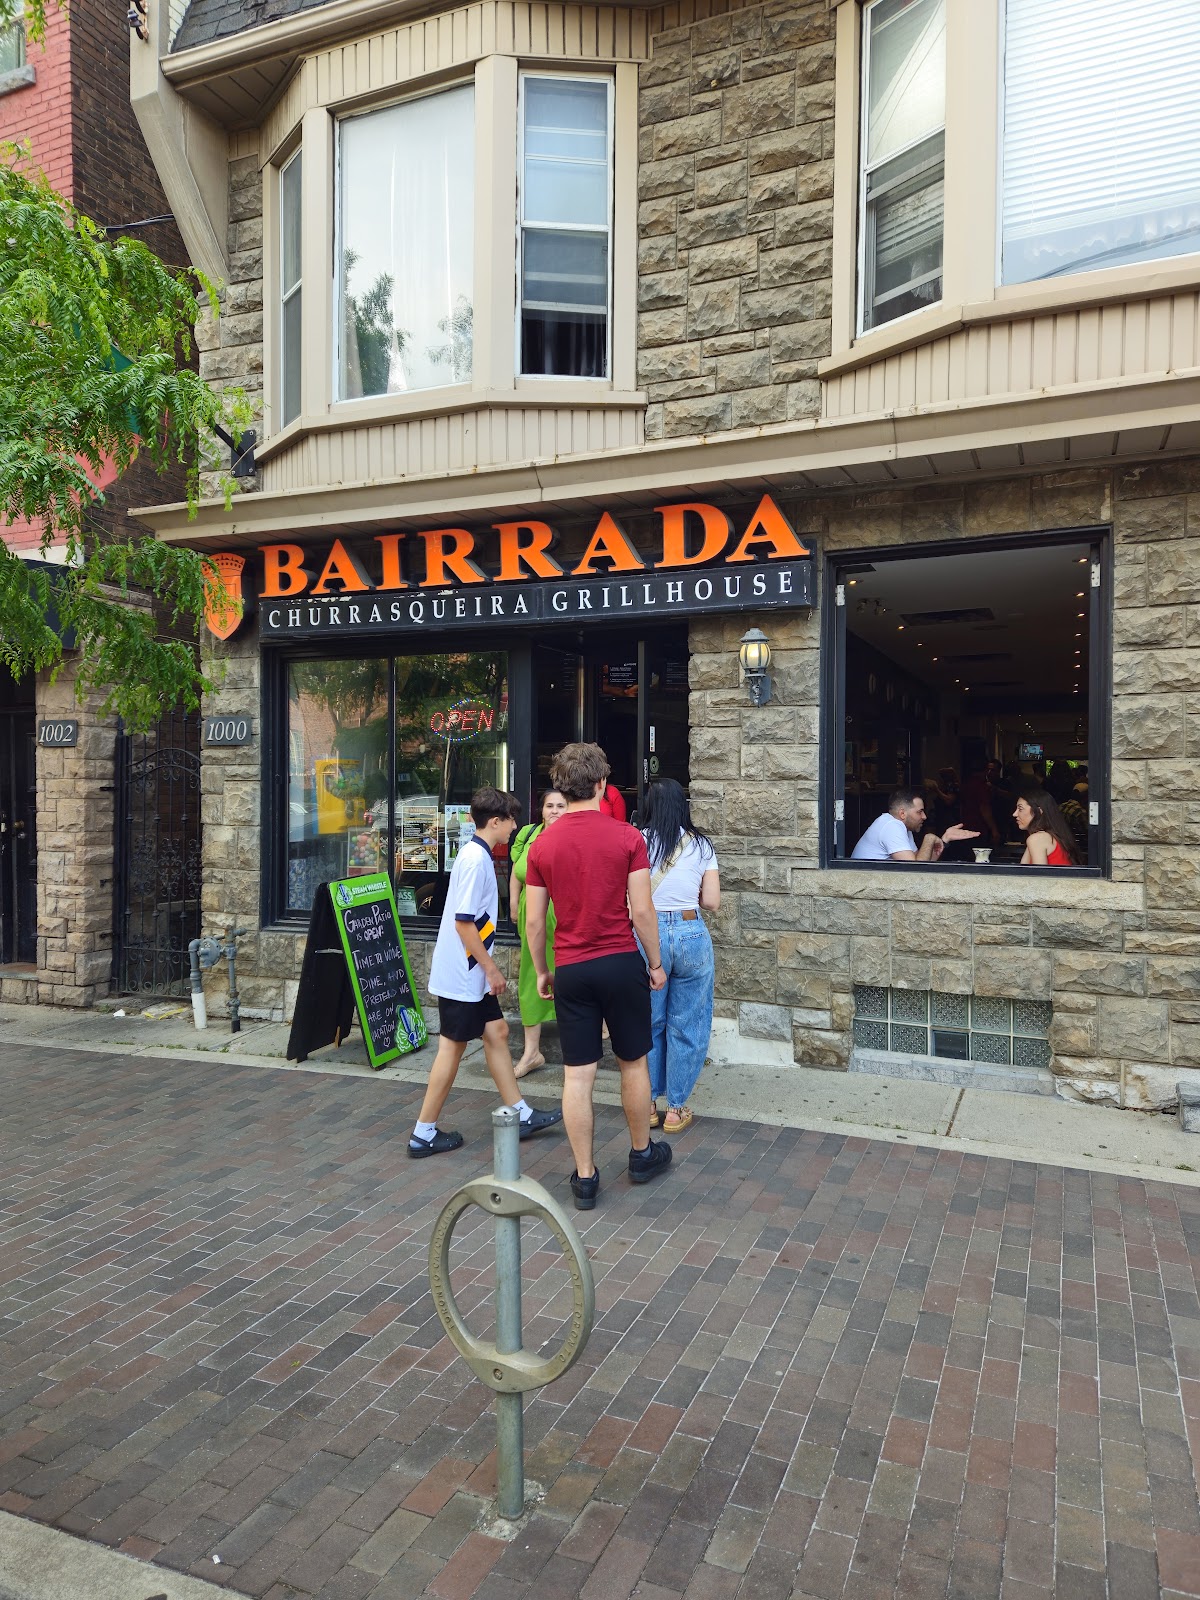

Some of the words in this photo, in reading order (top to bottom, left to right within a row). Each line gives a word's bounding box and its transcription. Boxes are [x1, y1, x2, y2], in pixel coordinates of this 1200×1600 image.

[258, 493, 810, 598] BAIRRADA
[268, 592, 530, 629] CHURRASQUEIRA
[551, 570, 795, 613] GRILLHOUSE
[206, 720, 248, 741] 1000
[430, 709, 495, 732] OPEN
[39, 724, 73, 743] 1002
[351, 885, 367, 895] STEAM
[397, 891, 413, 900] ASS
[344, 909, 374, 933] GARDEN
[352, 949, 375, 971] TIME
[399, 982, 410, 995] WE
[367, 1010, 382, 1024] ARE
[385, 1003, 394, 1017] ON
[556, 1232, 574, 1261] CITY
[572, 1273, 582, 1290] OF
[560, 1302, 583, 1362] TORONTO
